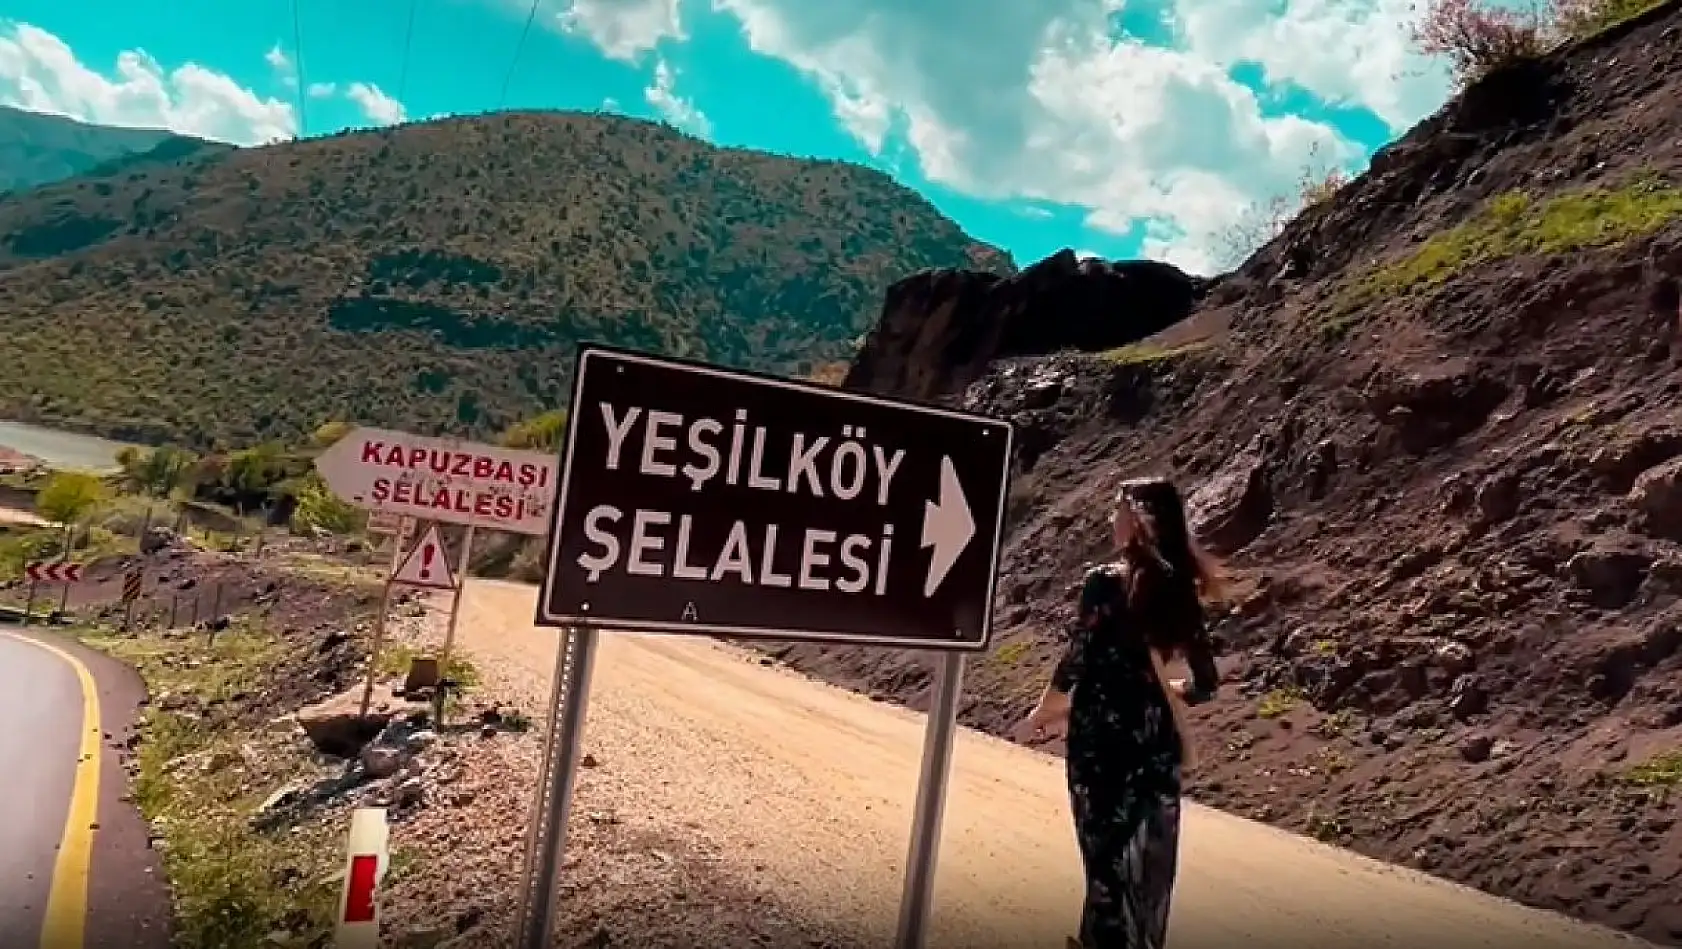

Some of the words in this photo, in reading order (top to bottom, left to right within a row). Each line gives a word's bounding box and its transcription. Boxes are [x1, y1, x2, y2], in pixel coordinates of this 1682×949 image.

[361, 440, 548, 489] KAPUZBAŞI
[599, 402, 906, 505] YEŞİLKÖY
[577, 505, 894, 596] ŞELALESİ
